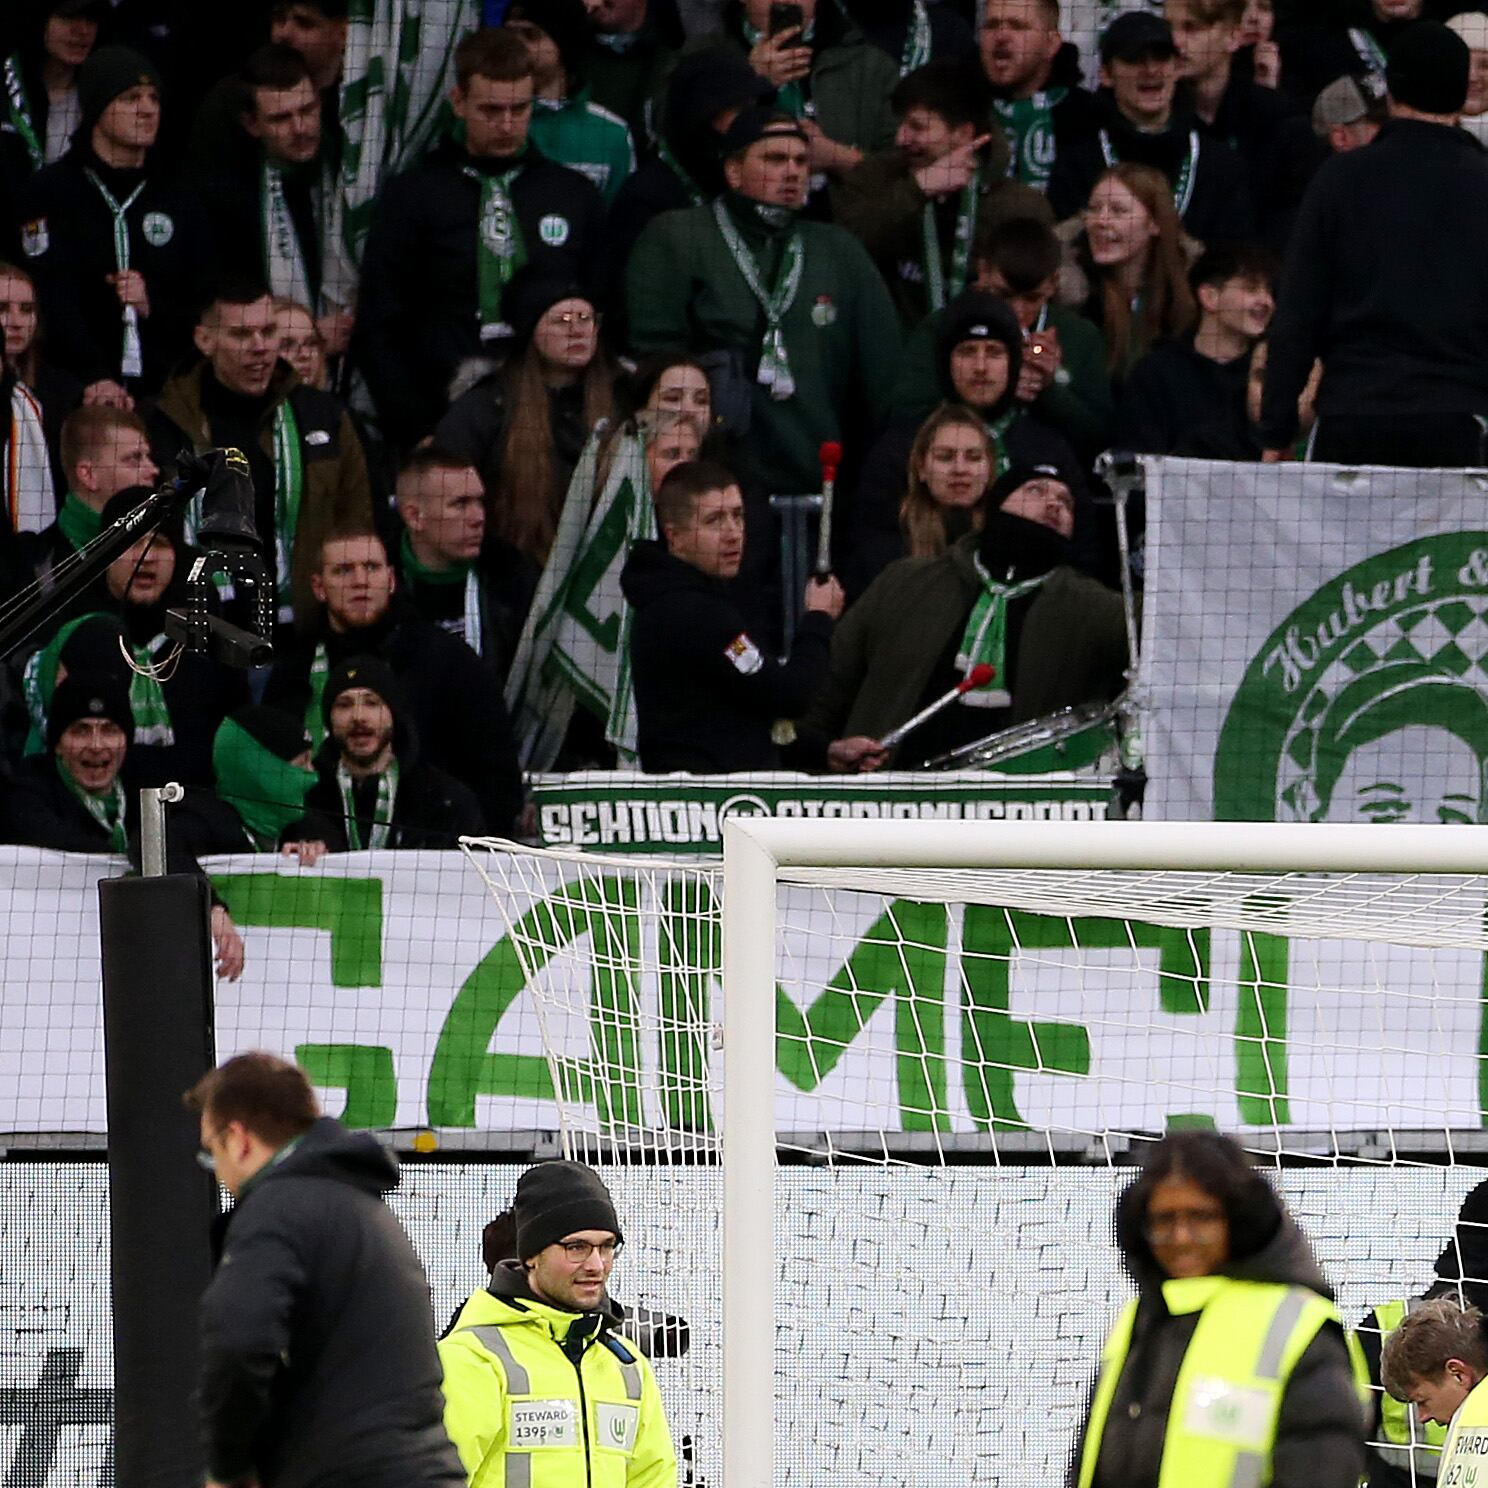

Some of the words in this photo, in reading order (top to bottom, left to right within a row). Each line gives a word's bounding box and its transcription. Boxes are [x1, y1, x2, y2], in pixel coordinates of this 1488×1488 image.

[1262, 556, 1436, 693] Hubert
[515, 1410, 568, 1423] STEWARD
[516, 1426, 547, 1438] 1395
